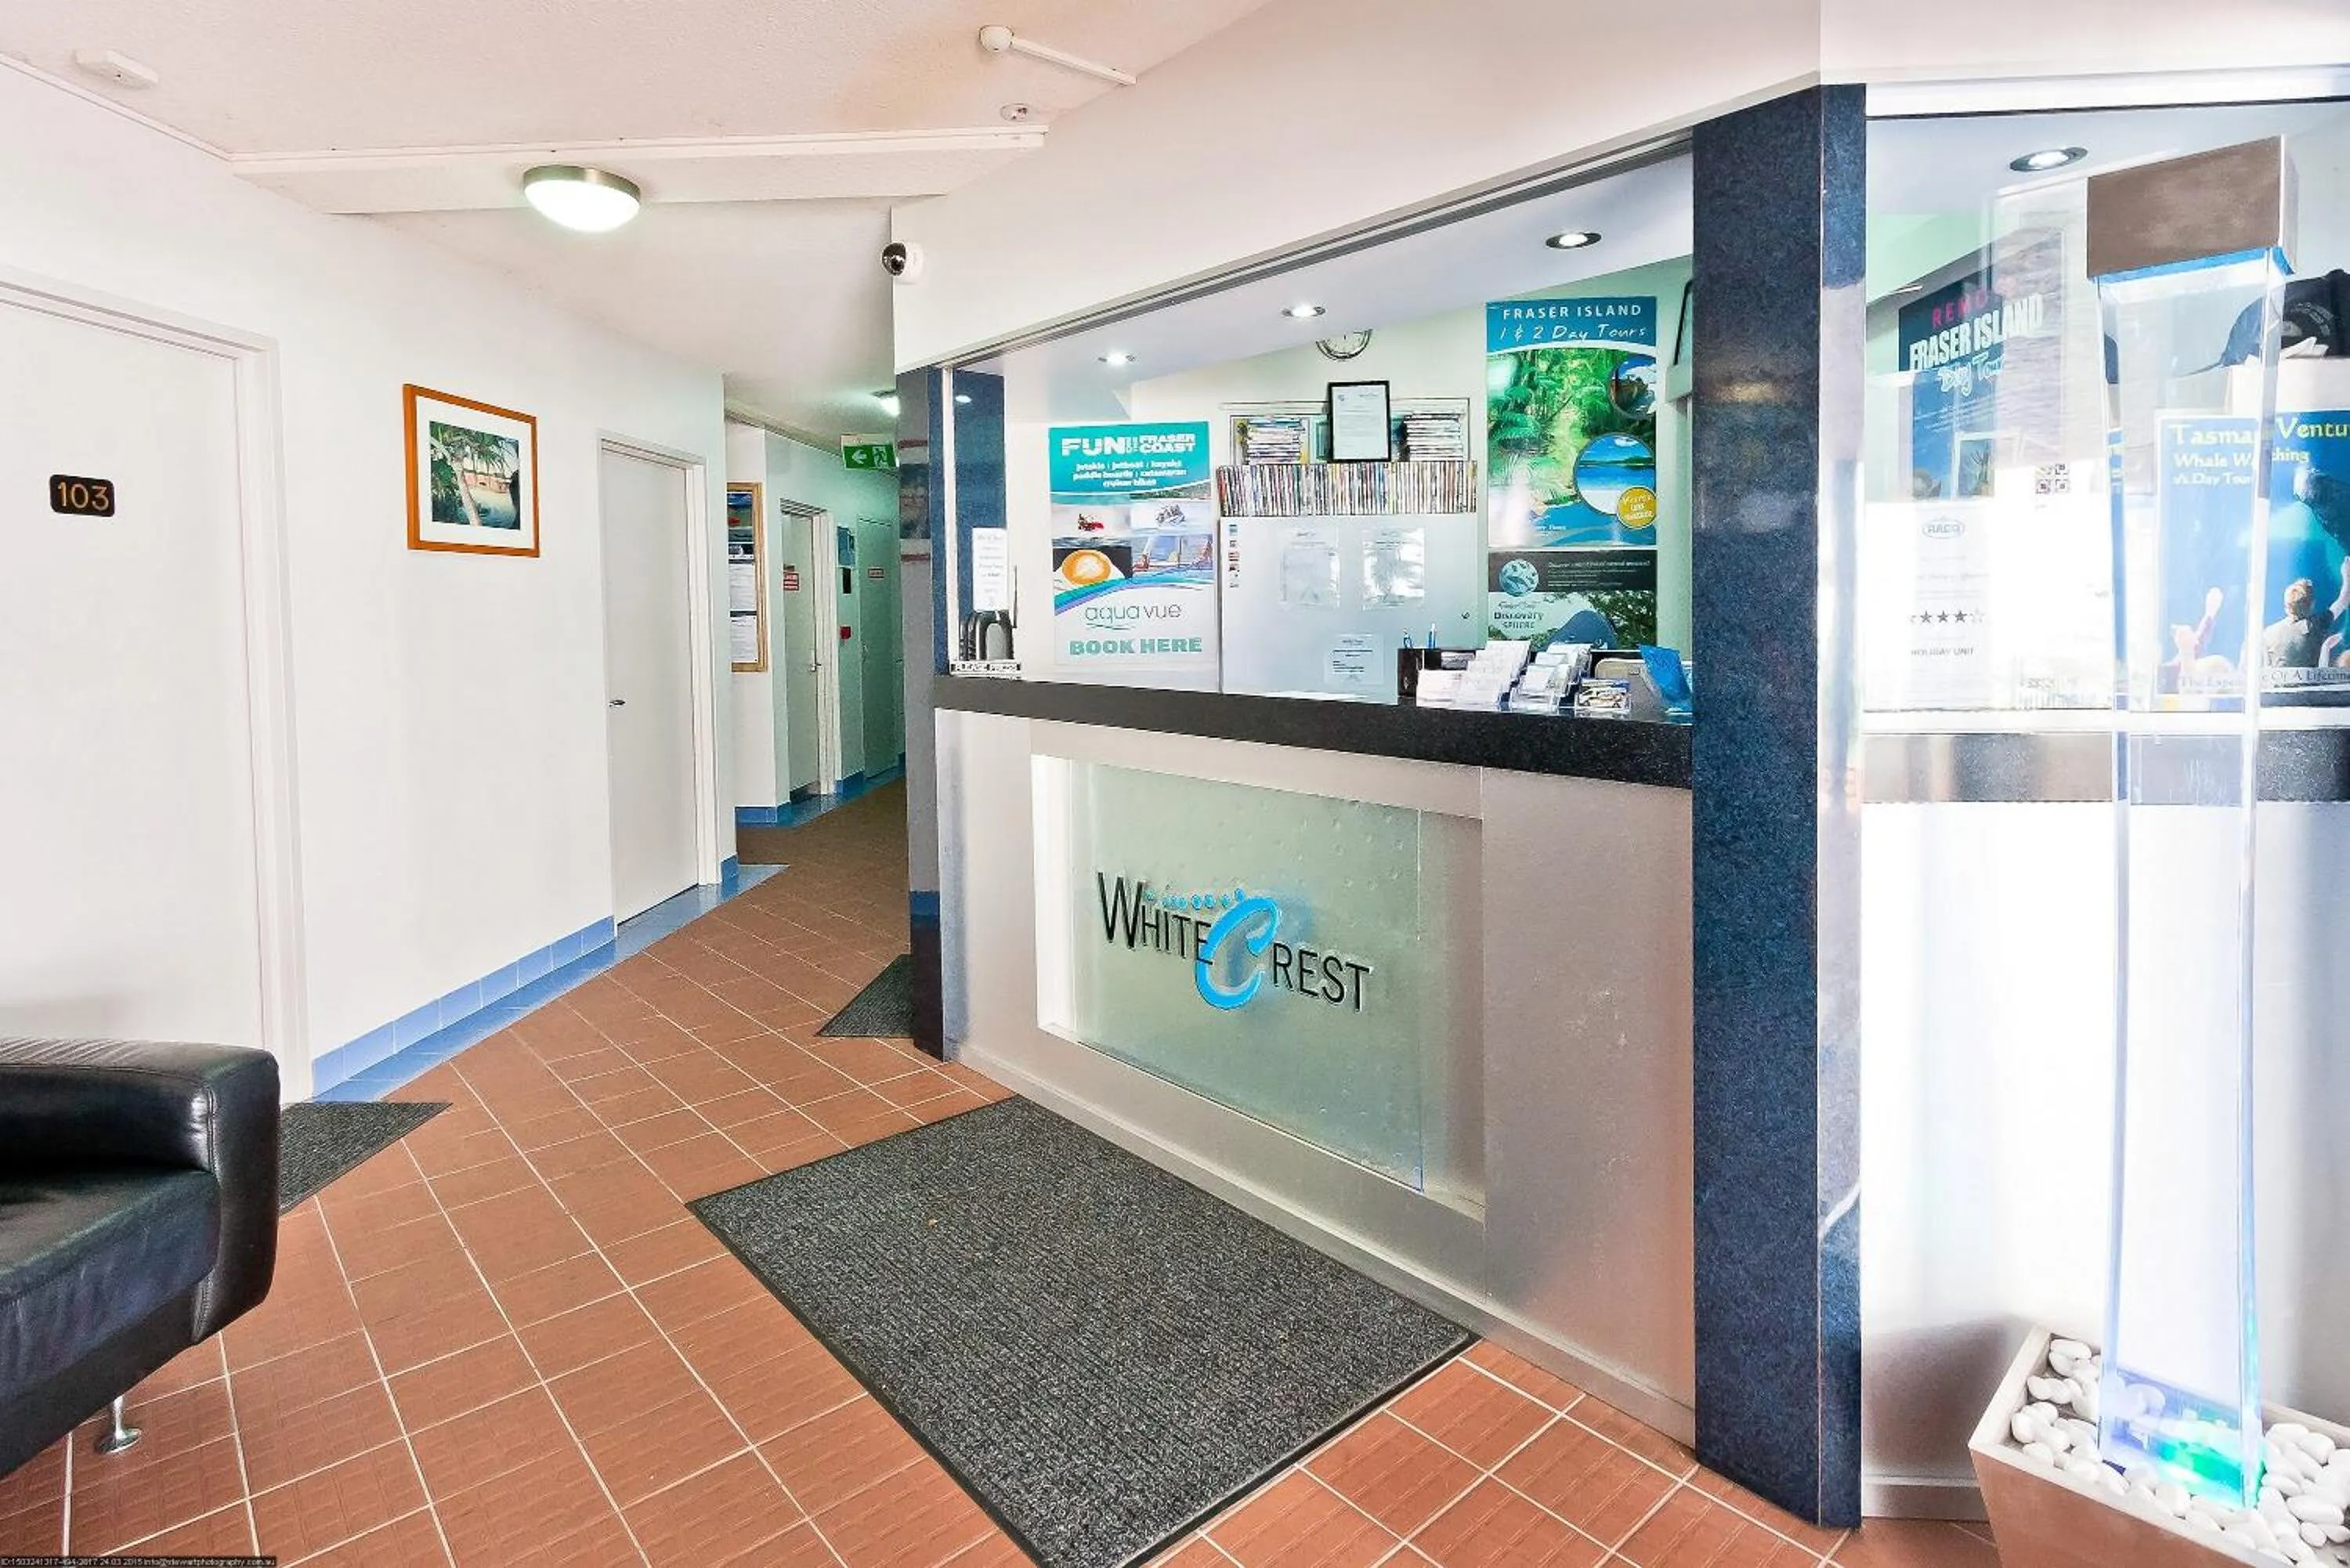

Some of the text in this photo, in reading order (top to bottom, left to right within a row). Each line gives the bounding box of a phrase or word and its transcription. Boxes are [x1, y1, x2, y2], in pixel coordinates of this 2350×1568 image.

[1502, 305, 1642, 320] FRASER ISLAND
[1500, 323, 1647, 342] 1 & 2 Day Tours
[1909, 293, 2044, 371] FRASER ISLAND
[1140, 433, 1196, 443] FRASER
[2167, 416, 2350, 446] Tasma Ventu
[1061, 436, 1126, 457] FUN
[1140, 442, 1196, 453] COAST
[2172, 452, 2229, 468] Whale
[2193, 472, 2221, 486] Day
[57, 482, 109, 511] 103
[1085, 603, 1182, 623] aqua vue
[1069, 637, 1203, 656] BOOK HERE
